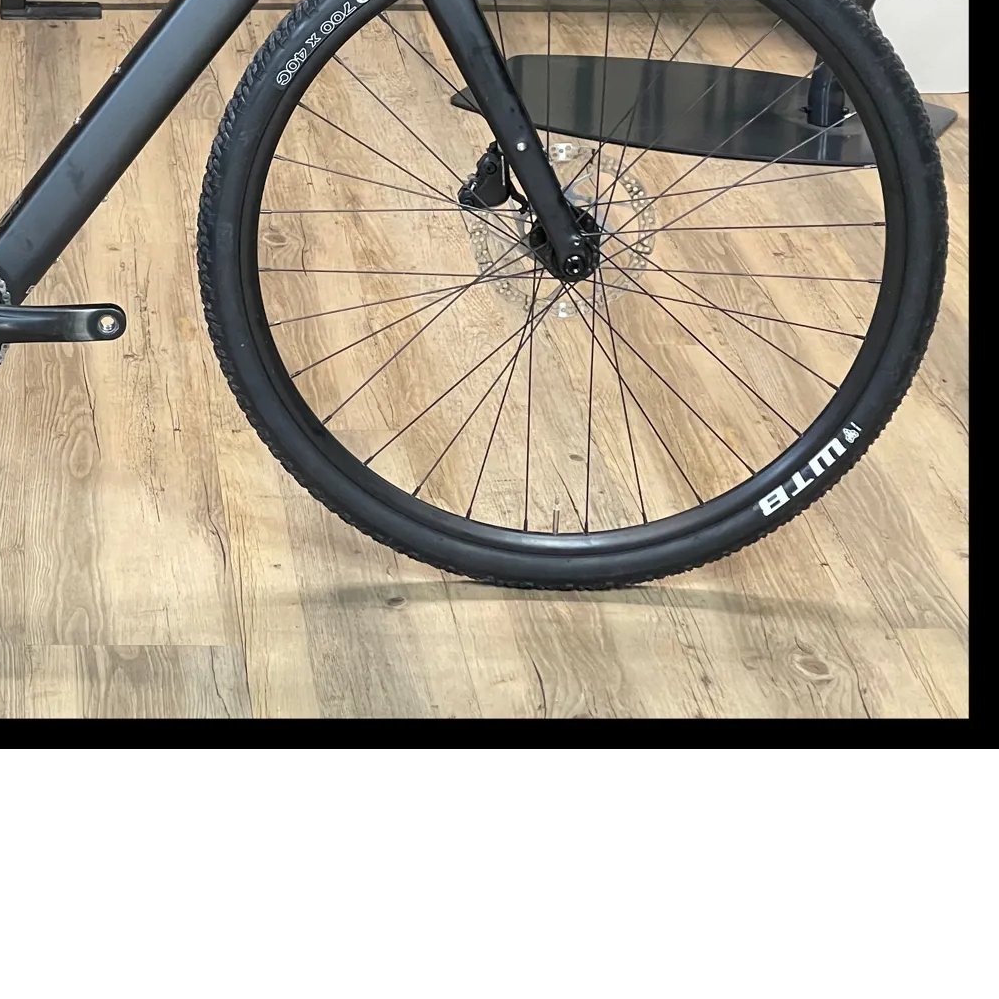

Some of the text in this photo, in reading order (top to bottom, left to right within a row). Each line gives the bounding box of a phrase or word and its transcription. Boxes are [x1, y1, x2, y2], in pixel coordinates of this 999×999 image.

[320, 1, 357, 35] 700
[276, 47, 307, 86] 40C
[758, 437, 847, 517] WTB
